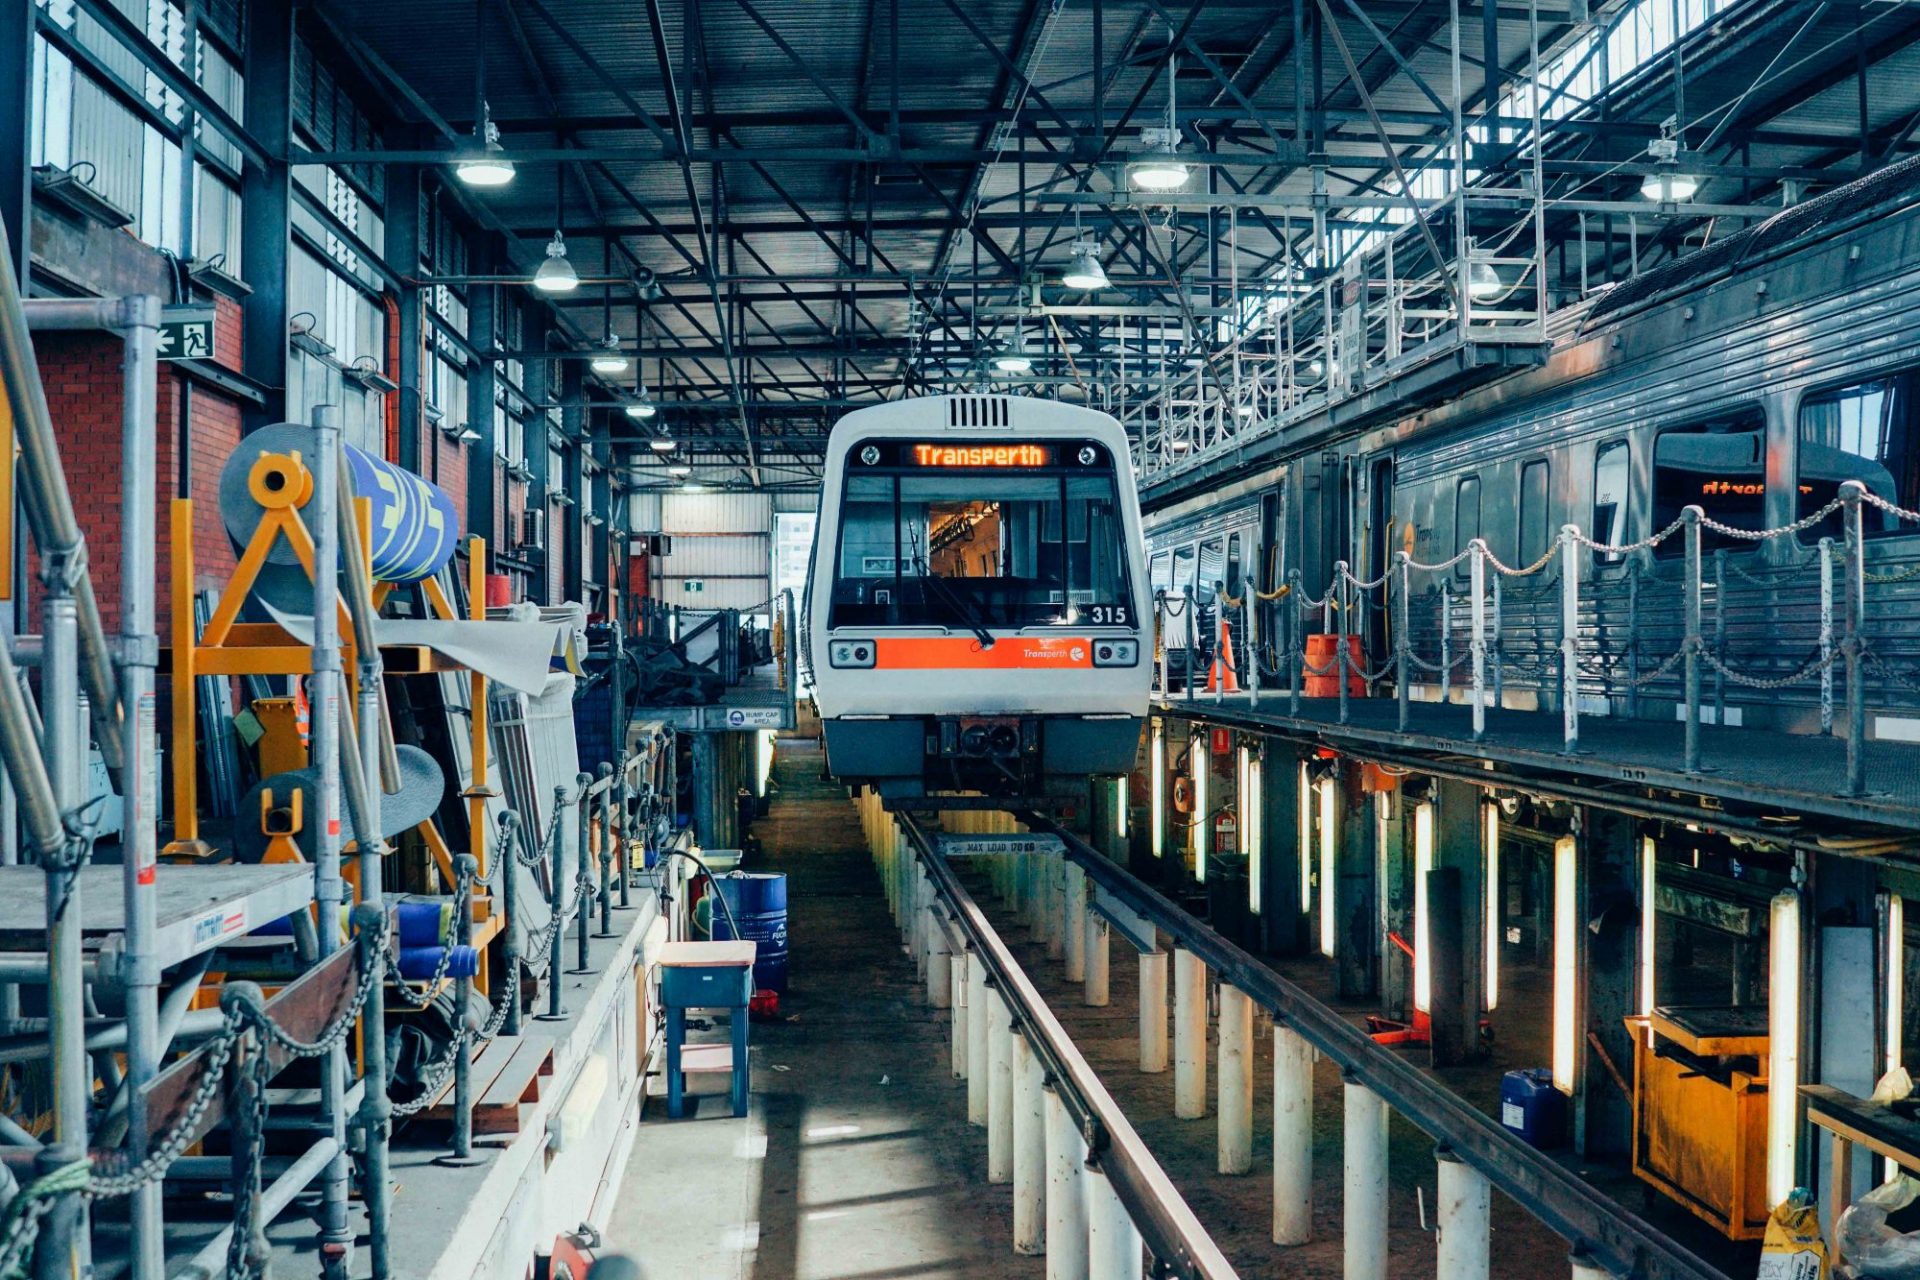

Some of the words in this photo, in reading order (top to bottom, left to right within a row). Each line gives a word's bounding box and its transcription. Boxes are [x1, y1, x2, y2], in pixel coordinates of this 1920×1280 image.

[915, 444, 1042, 466] Transperth
[1092, 606, 1126, 623] 315
[1023, 649, 1067, 659] Transperth
[967, 842, 982, 852] MAX
[988, 842, 1005, 852] LOAD
